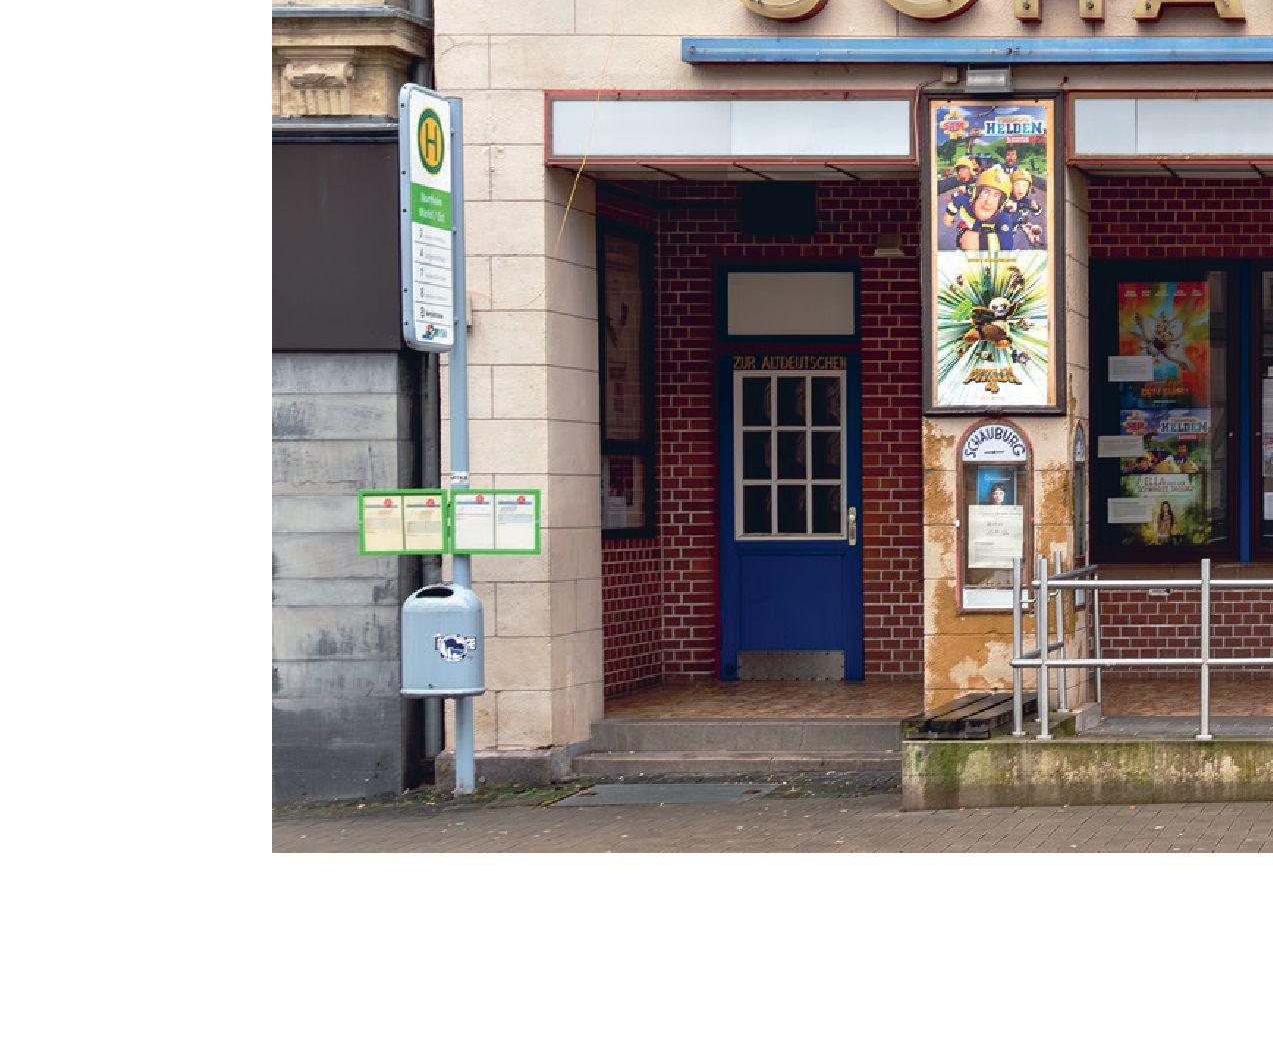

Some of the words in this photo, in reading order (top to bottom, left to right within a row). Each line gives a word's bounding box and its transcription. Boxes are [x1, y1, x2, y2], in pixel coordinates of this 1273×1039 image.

[985, 121, 1044, 135] HELDEN
[733, 355, 756, 369] ZUR
[964, 426, 1025, 458] SCHAUBURG
